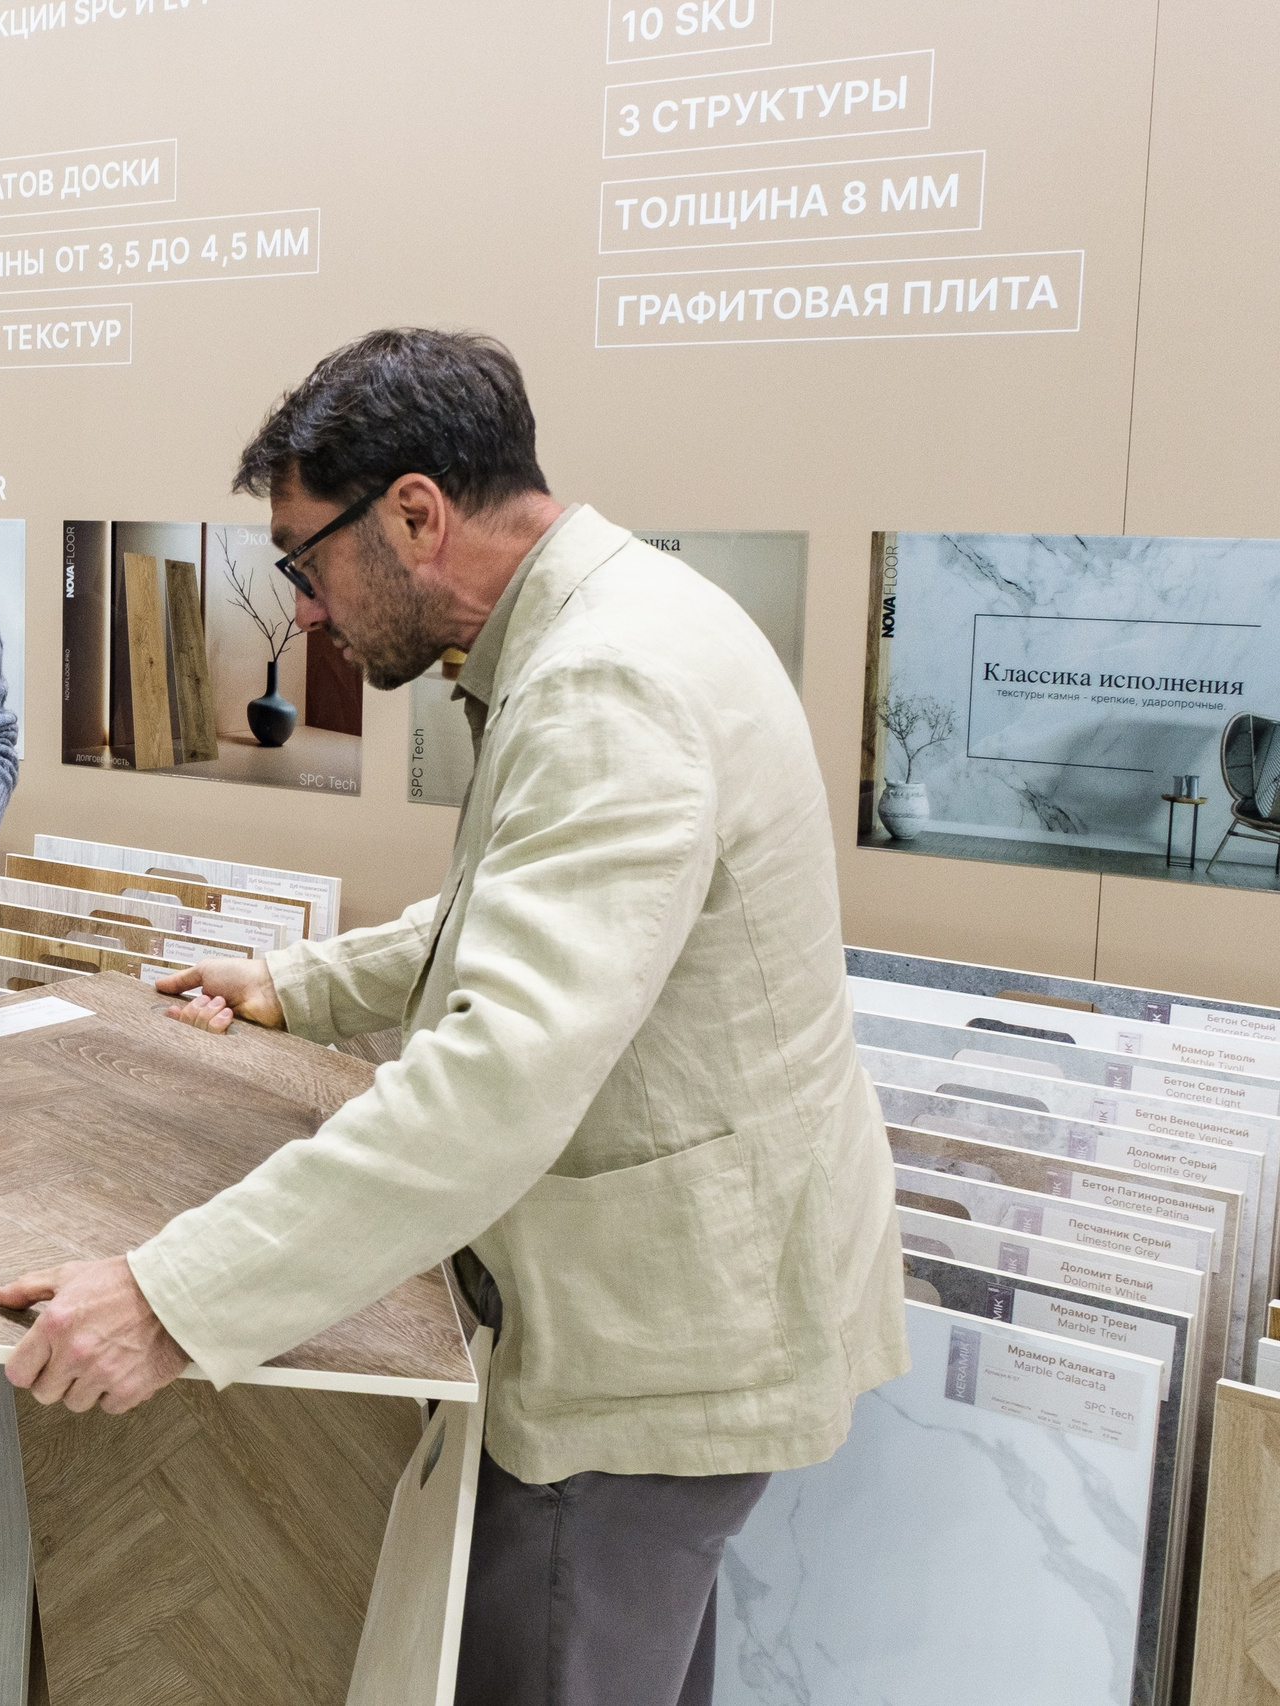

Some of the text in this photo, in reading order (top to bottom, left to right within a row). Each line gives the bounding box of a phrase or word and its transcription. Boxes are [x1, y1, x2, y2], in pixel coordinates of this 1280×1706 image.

[74, 0, 127, 25] SPC
[620, 0, 756, 42] 10 SKU
[619, 75, 909, 138] 3 СТРУКТУРЫ
[61, 156, 160, 199] ДОСКИ
[615, 173, 960, 231] ТОЛЩИНА 8 ММ
[54, 245, 90, 273] ОТ
[99, 239, 141, 274] 3,5
[148, 236, 190, 272] ДО
[200, 232, 248, 268] 4,5
[256, 227, 310, 259] ММ
[618, 275, 1059, 328] ГРАФИТОВАЯ ПЛИТА
[3, 319, 121, 352] ТЕКСТУР
[66, 526, 75, 598] NOVAFLOOR
[881, 546, 899, 638] NOVAFLOOR
[983, 662, 1244, 696] Классика исполнения
[997, 689, 1045, 700] текстуры
[1048, 692, 1080, 701] камня
[1091, 694, 1138, 707] крепкие,
[1141, 699, 1227, 711] ударопрочные.
[411, 728, 424, 797] SPC Tech
[299, 773, 357, 791] SPC Tech
[1207, 1014, 1276, 1032] Бетон Серый
[1172, 1043, 1256, 1064] Мрамор Тиволи
[1163, 1076, 1246, 1098] Бетон Светлый
[1166, 1088, 1241, 1109] Concrete Light
[1135, 1109, 1249, 1138] Бетон Венецианский
[1148, 1123, 1233, 1147] Concrete Venice
[1127, 1146, 1217, 1171] Доломит Серый
[1133, 1159, 1207, 1183] Dolomite Grey
[1082, 1179, 1114, 1193] Бетон
[1117, 1186, 1215, 1214] Патинорованный
[1104, 1196, 1190, 1221] Concrete Patina
[1068, 1218, 1171, 1249] Песчанник Серый
[1076, 1233, 1160, 1260] Limestone Grey
[1060, 1261, 1153, 1290] Доломит Белый
[1063, 1275, 1147, 1302] Dolomite White
[1050, 1302, 1137, 1332] Мрамор Треви
[1057, 1317, 1127, 1343] Marble Trevi
[955, 1342, 971, 1399] KERAMIK
[1007, 1344, 1116, 1381] Мрамор Калаката
[1014, 1360, 1106, 1392] Marble Calacata
[1084, 1400, 1134, 1421] SPC Tech
